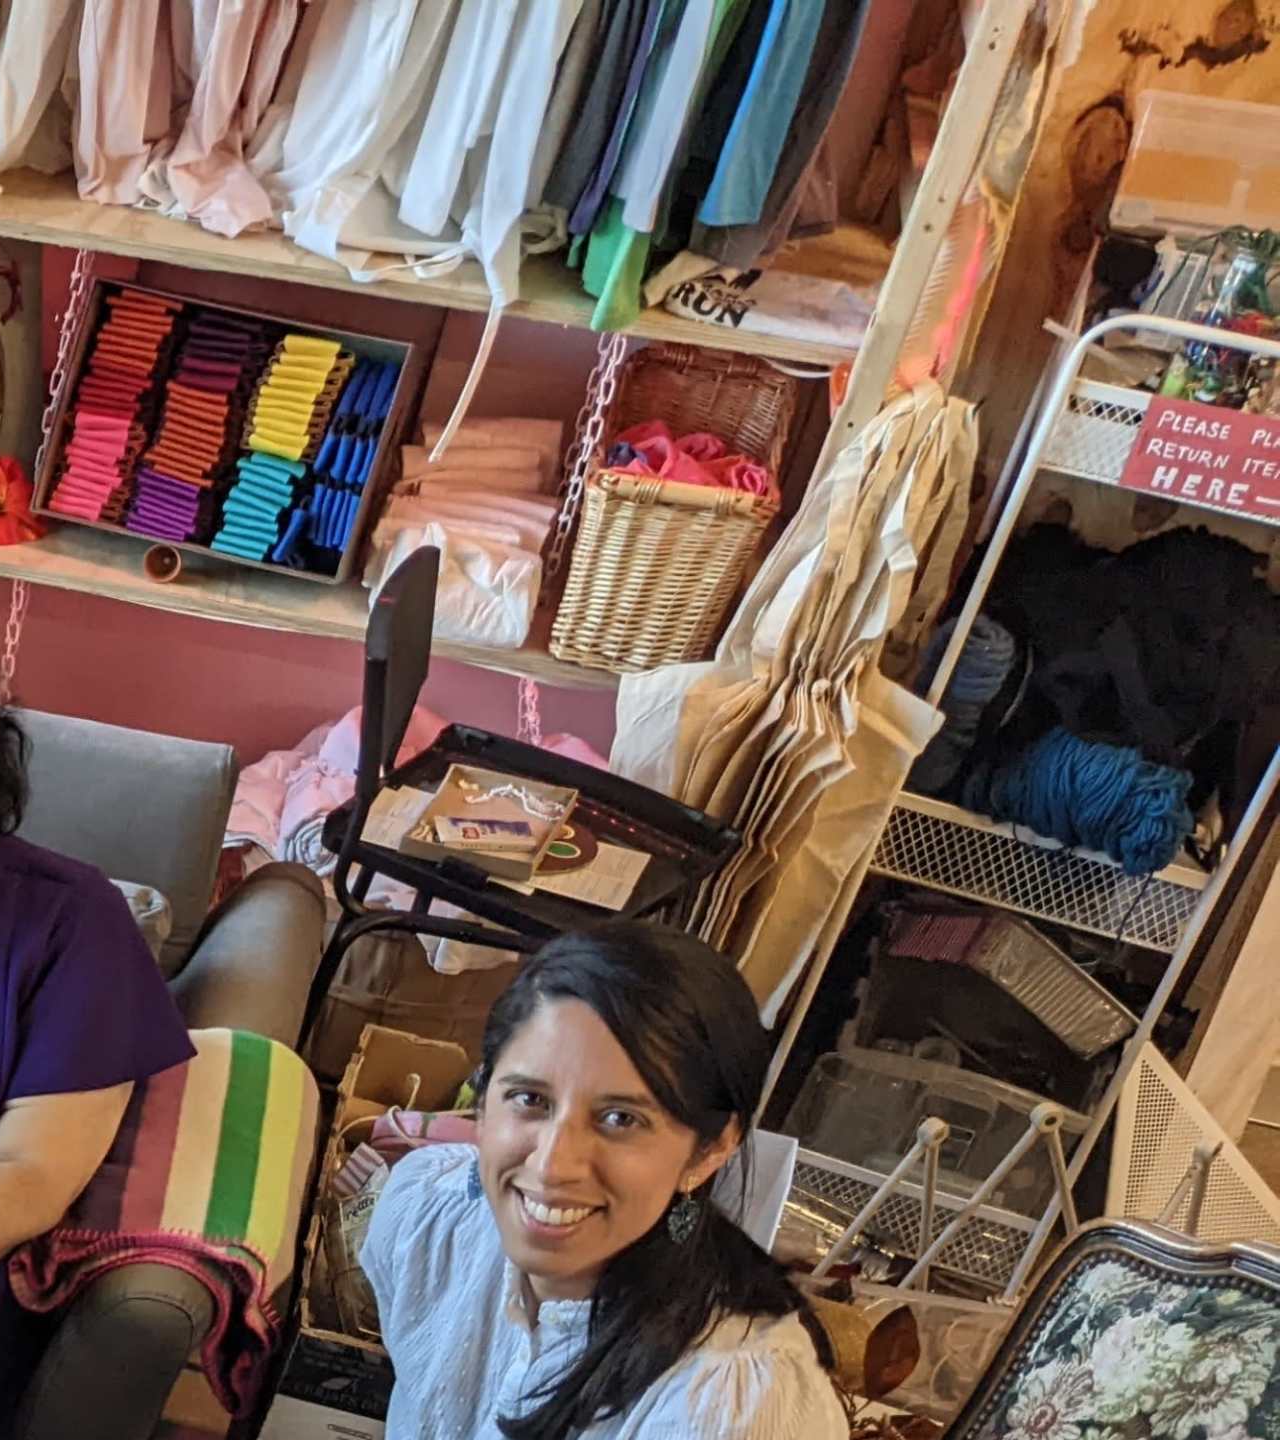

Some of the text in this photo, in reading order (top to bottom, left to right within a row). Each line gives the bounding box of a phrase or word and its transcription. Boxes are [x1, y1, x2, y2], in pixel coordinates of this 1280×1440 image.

[1157, 409, 1280, 449] PLEASE PLA
[1145, 437, 1230, 469] RETURN
[1150, 465, 1250, 505] HERE
